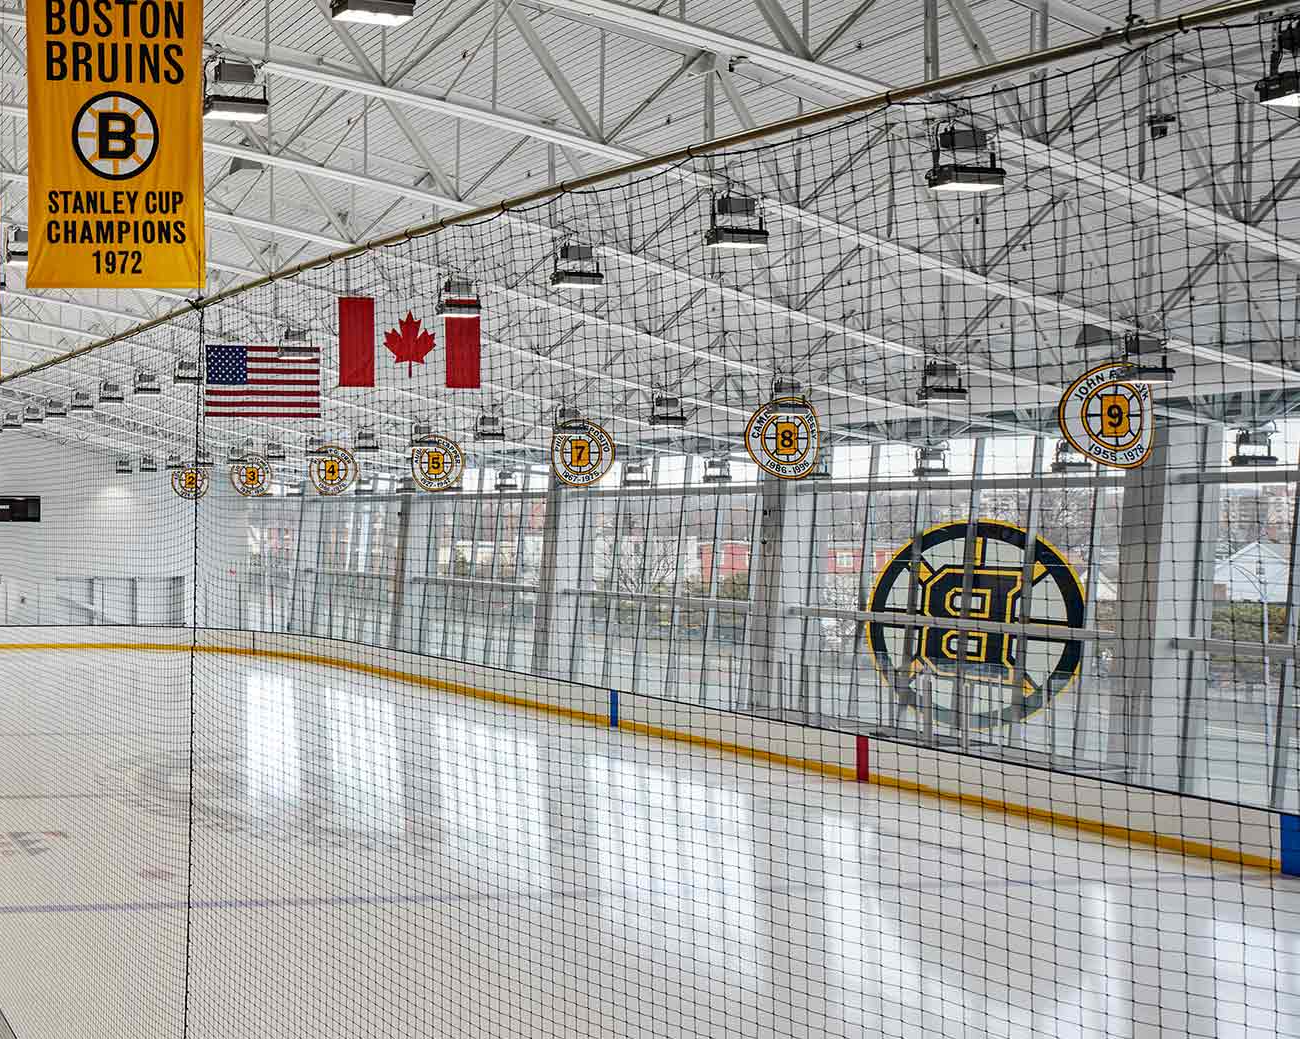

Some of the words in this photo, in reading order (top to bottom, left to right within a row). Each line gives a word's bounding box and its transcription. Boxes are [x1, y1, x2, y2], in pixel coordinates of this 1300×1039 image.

[46, 0, 184, 38] BOSTON
[46, 41, 184, 84] BRUINS
[98, 112, 136, 159] B
[48, 191, 139, 214] STANLEY
[145, 191, 184, 214] CUP
[47, 221, 186, 244] CHAMPIONS
[92, 251, 142, 274] 1972
[1074, 374, 1105, 400] JOHN
[1107, 405, 1123, 427] 9
[780, 430, 793, 447] 8
[431, 457, 440, 469] 5
[575, 445, 585, 461] 7
[1088, 443, 1145, 462] 1955-1978
[187, 475, 195, 485] 2
[248, 470, 256, 481] 3
[327, 464, 336, 476] 4
